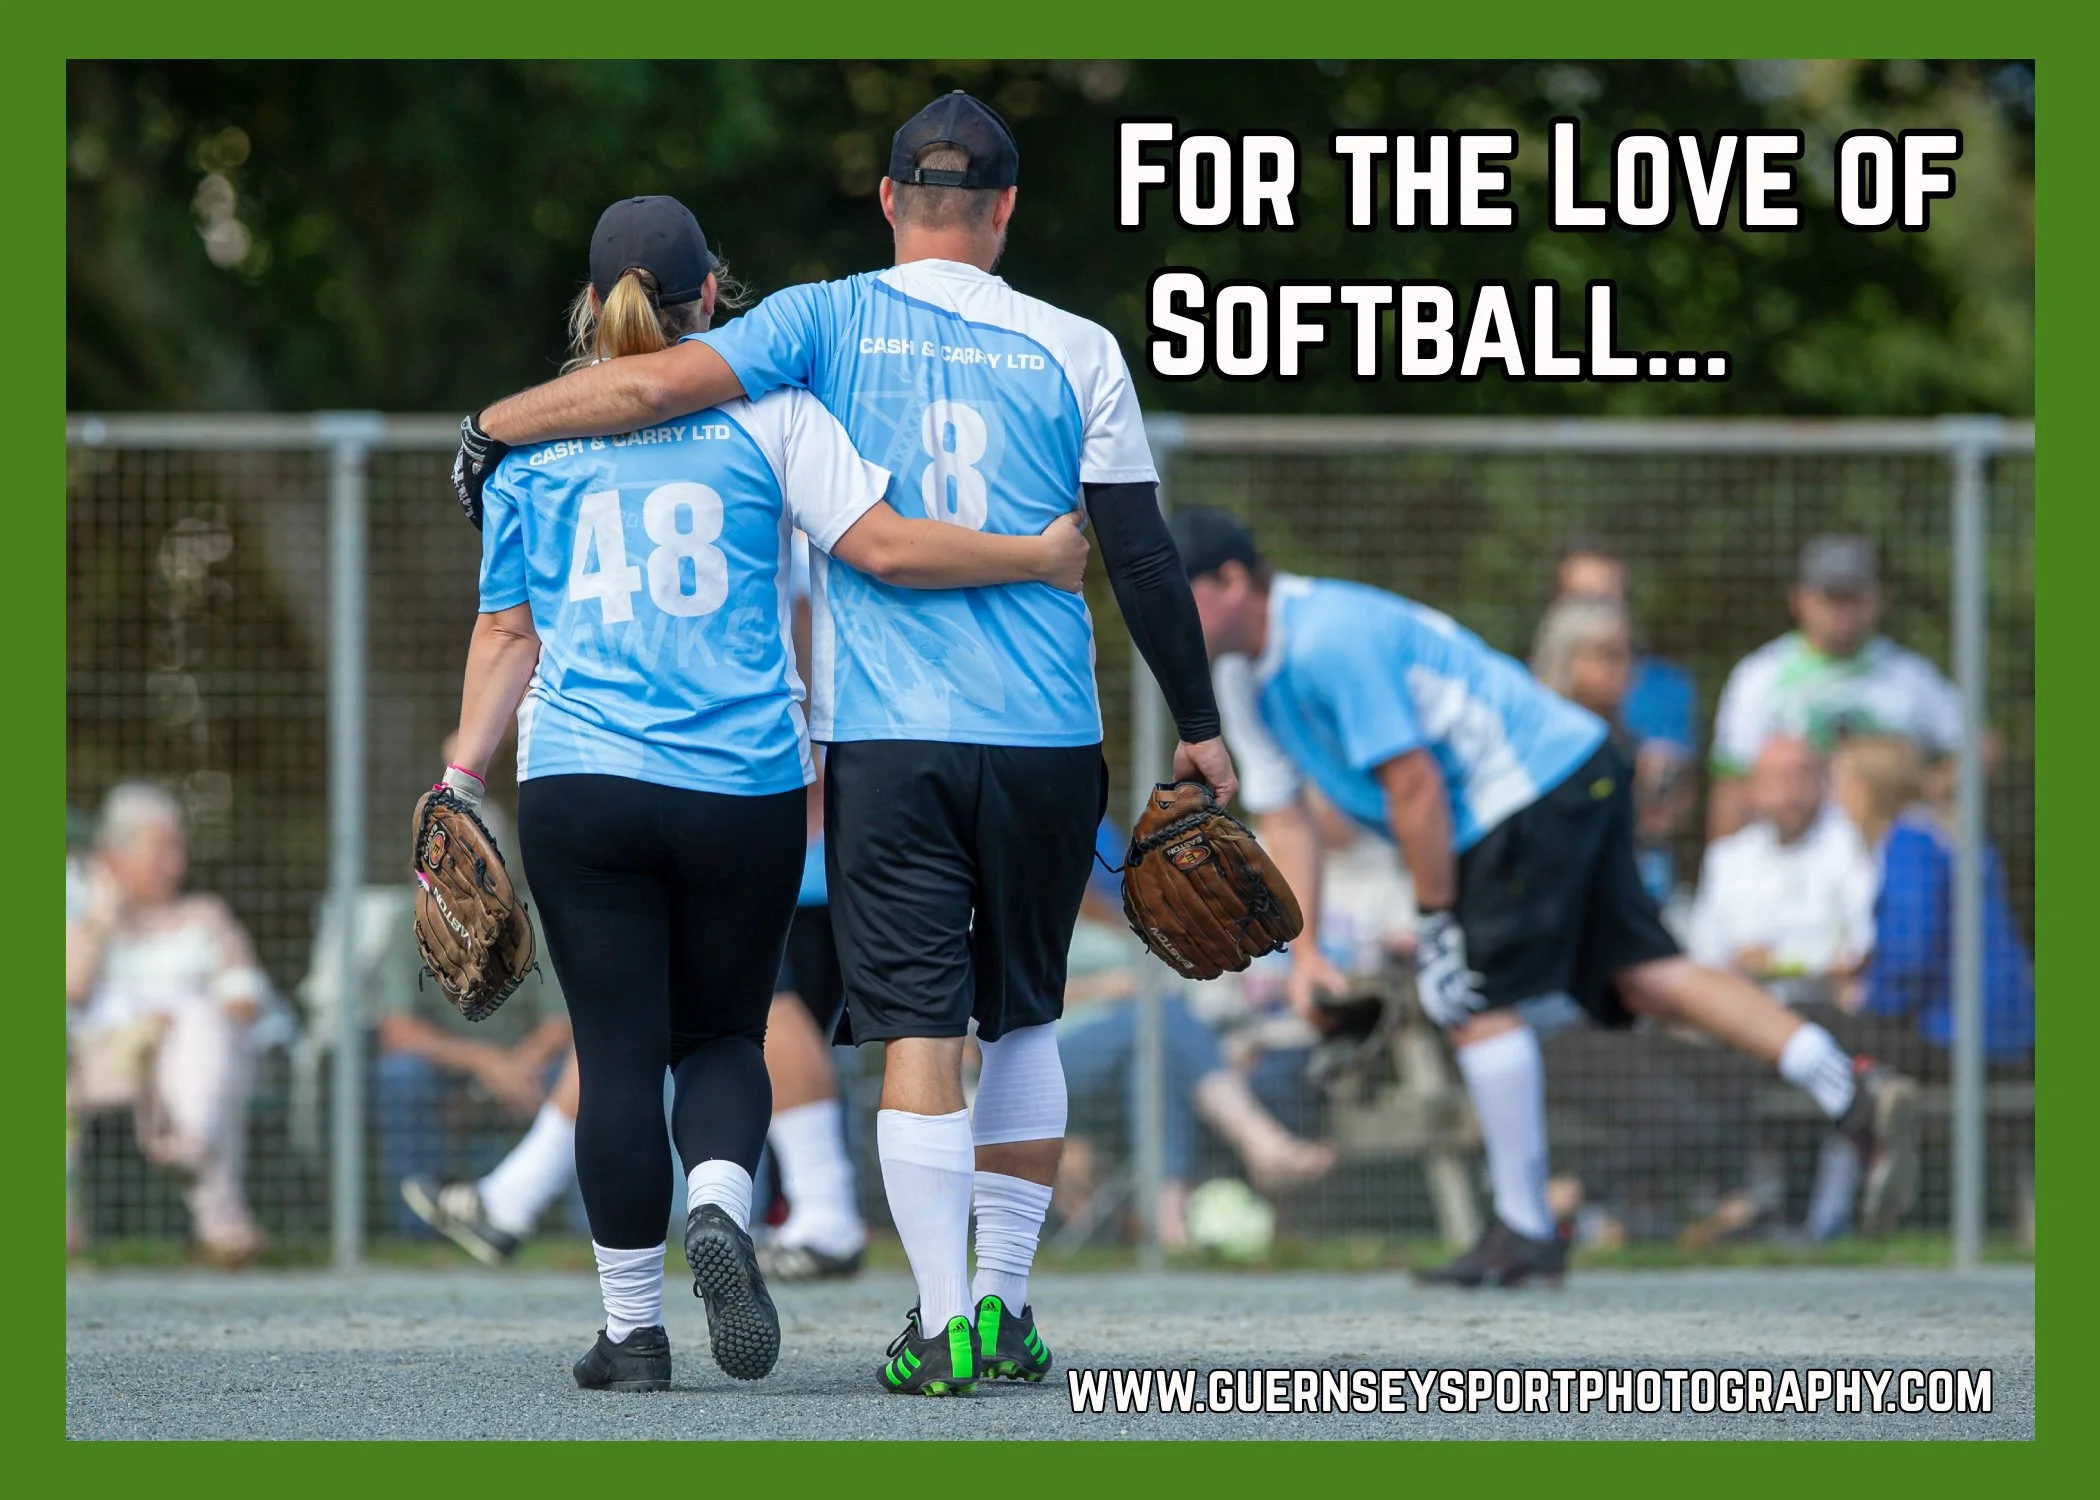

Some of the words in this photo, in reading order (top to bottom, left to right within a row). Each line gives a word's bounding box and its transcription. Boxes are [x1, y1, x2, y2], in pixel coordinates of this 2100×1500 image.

[860, 337, 914, 356] CASH
[921, 341, 935, 357] &
[941, 346, 1002, 369] CARRY
[1007, 353, 1045, 370] LTD
[529, 439, 583, 466] CASH
[591, 436, 605, 449] &
[613, 425, 686, 447] CARRY
[692, 424, 730, 440] LTD
[922, 399, 987, 532] 8
[568, 482, 729, 625] 48
[1167, 836, 1202, 856] EASTON
[1150, 927, 1195, 969] EASTON
